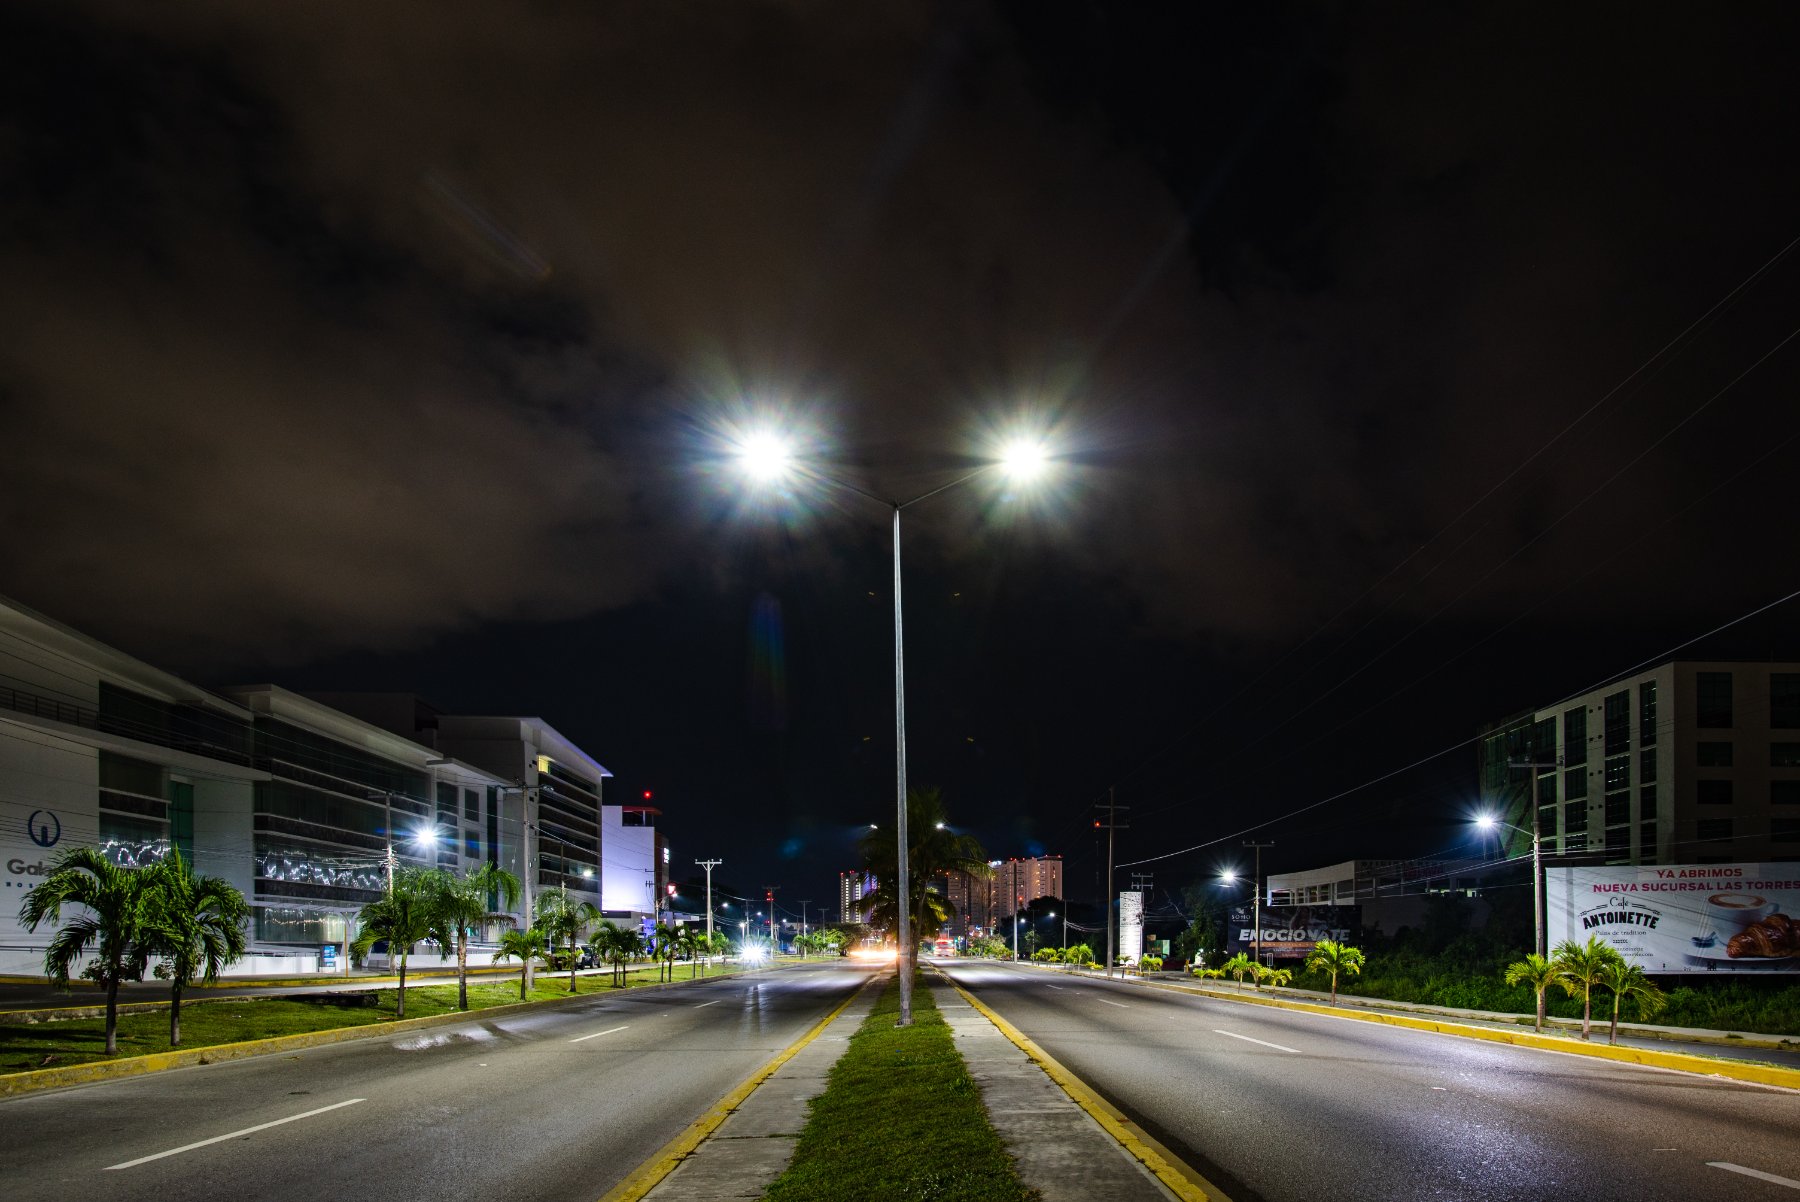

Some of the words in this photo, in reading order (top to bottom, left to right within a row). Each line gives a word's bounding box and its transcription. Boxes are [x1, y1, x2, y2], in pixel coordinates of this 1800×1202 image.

[1657, 869, 1675, 879] YA
[1679, 868, 1743, 878] ABRIMOS
[1593, 883, 1639, 893] NUEVA
[1641, 881, 1714, 892] SUCURSAL
[1716, 881, 1743, 891] LAS
[1745, 880, 1800, 890] TORRES
[1609, 896, 1629, 911] Café
[1582, 911, 1660, 930] ANTOINETTE
